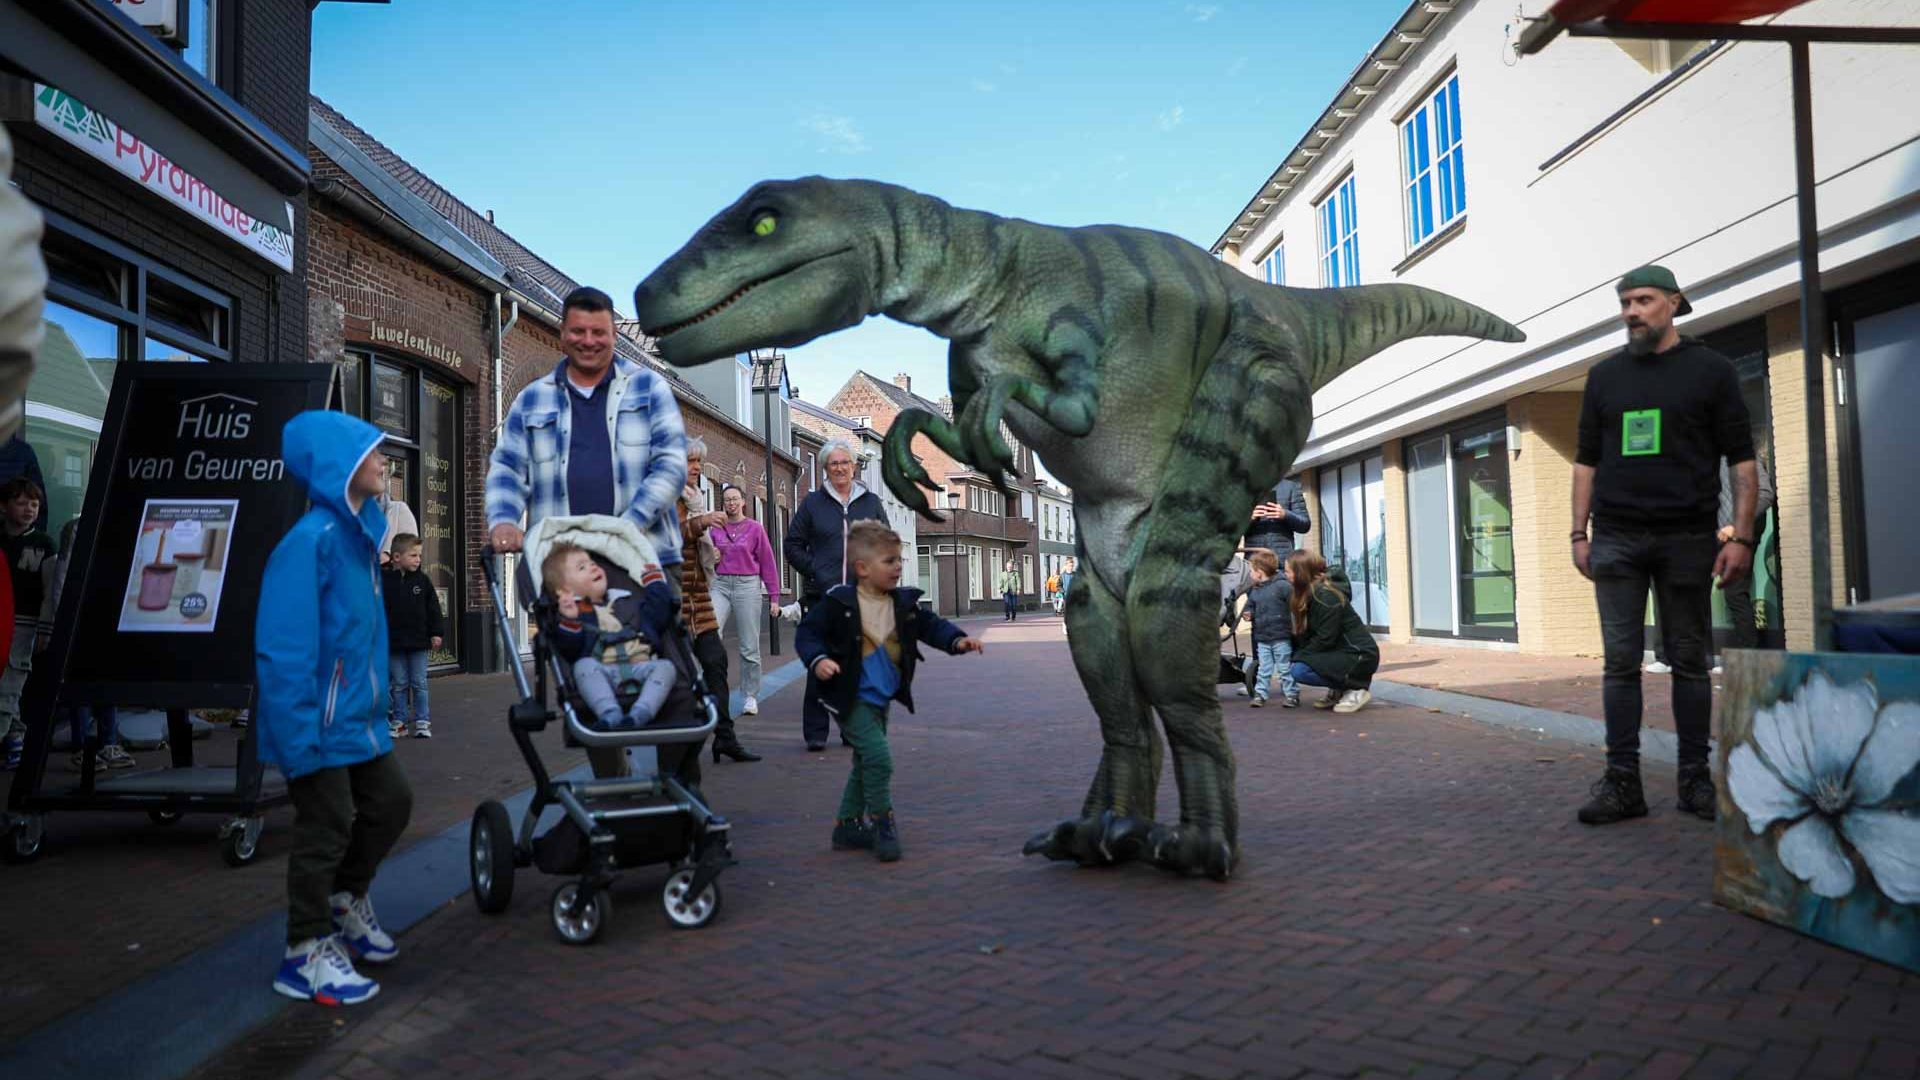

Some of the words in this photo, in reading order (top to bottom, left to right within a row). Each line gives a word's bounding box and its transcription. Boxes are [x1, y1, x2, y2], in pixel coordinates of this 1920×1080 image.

[115, 124, 249, 235] Pyramide
[370, 320, 462, 368] Juwelenhuisje
[176, 403, 251, 439] Huis
[128, 457, 174, 480] van
[184, 450, 285, 481] Geuren
